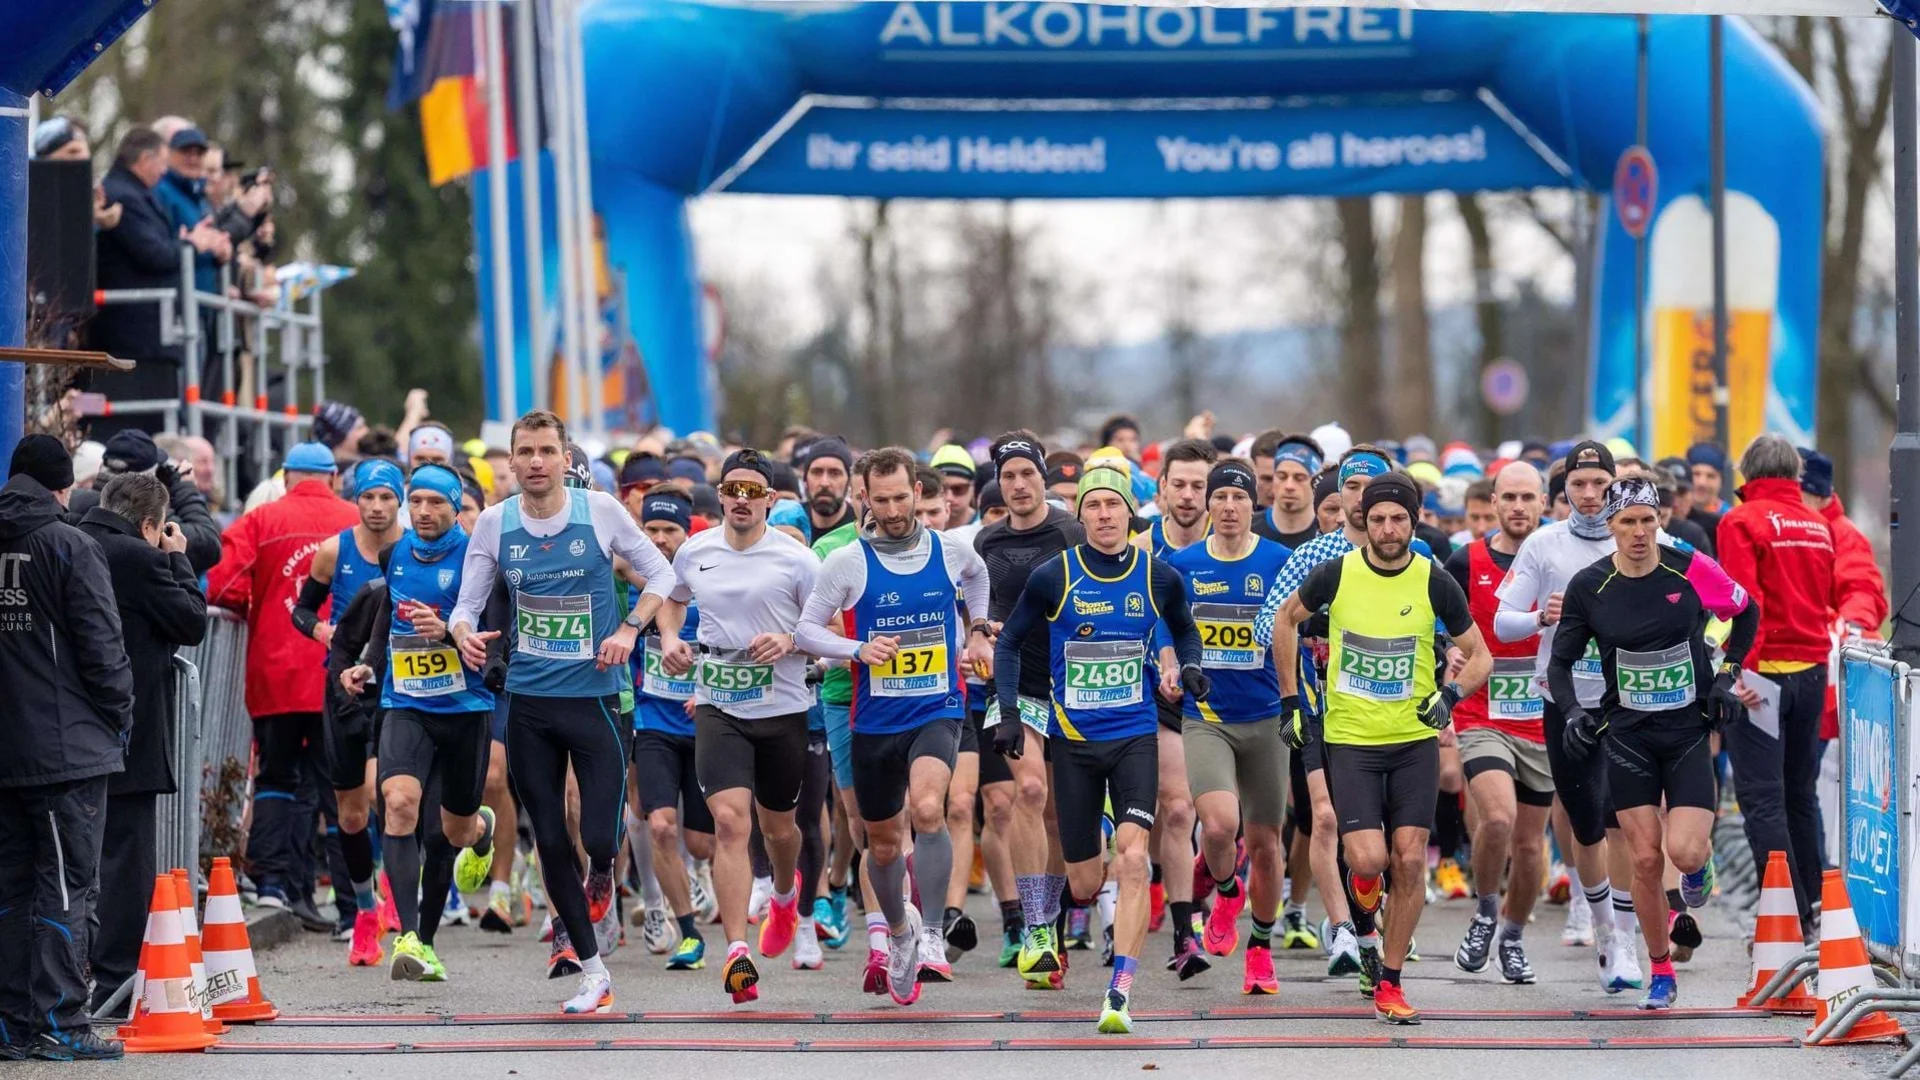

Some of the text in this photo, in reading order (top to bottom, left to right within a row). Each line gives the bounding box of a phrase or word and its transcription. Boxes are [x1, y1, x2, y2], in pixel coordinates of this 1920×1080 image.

[880, 3, 1414, 46] ALKOHOLFREI
[807, 134, 1106, 172] Ihr seid Helden!
[1156, 125, 1486, 172] You're all heroes!
[526, 569, 585, 580] Autohaus MANZ
[521, 612, 587, 638] 2574
[876, 611, 945, 627] BECK BAU
[529, 637, 581, 652] KURdirekt
[1204, 625, 1252, 647] 209
[404, 653, 448, 676] 159
[891, 650, 934, 675] 137
[1203, 650, 1254, 662] KURdirekt
[1345, 651, 1411, 681] 2598
[404, 675, 453, 690] KURdirekt
[705, 664, 770, 689] 2597
[883, 674, 937, 690] KURdirekt
[1071, 661, 1138, 687] 2480
[1350, 675, 1403, 694] KURdirekt
[1622, 665, 1689, 691] 2542
[653, 677, 696, 694] KURdirek
[711, 688, 762, 702] KURdirekt
[1078, 687, 1131, 702] KURdirekt
[1631, 689, 1685, 704] KURdirekt
[206, 969, 239, 993] ZEIT
